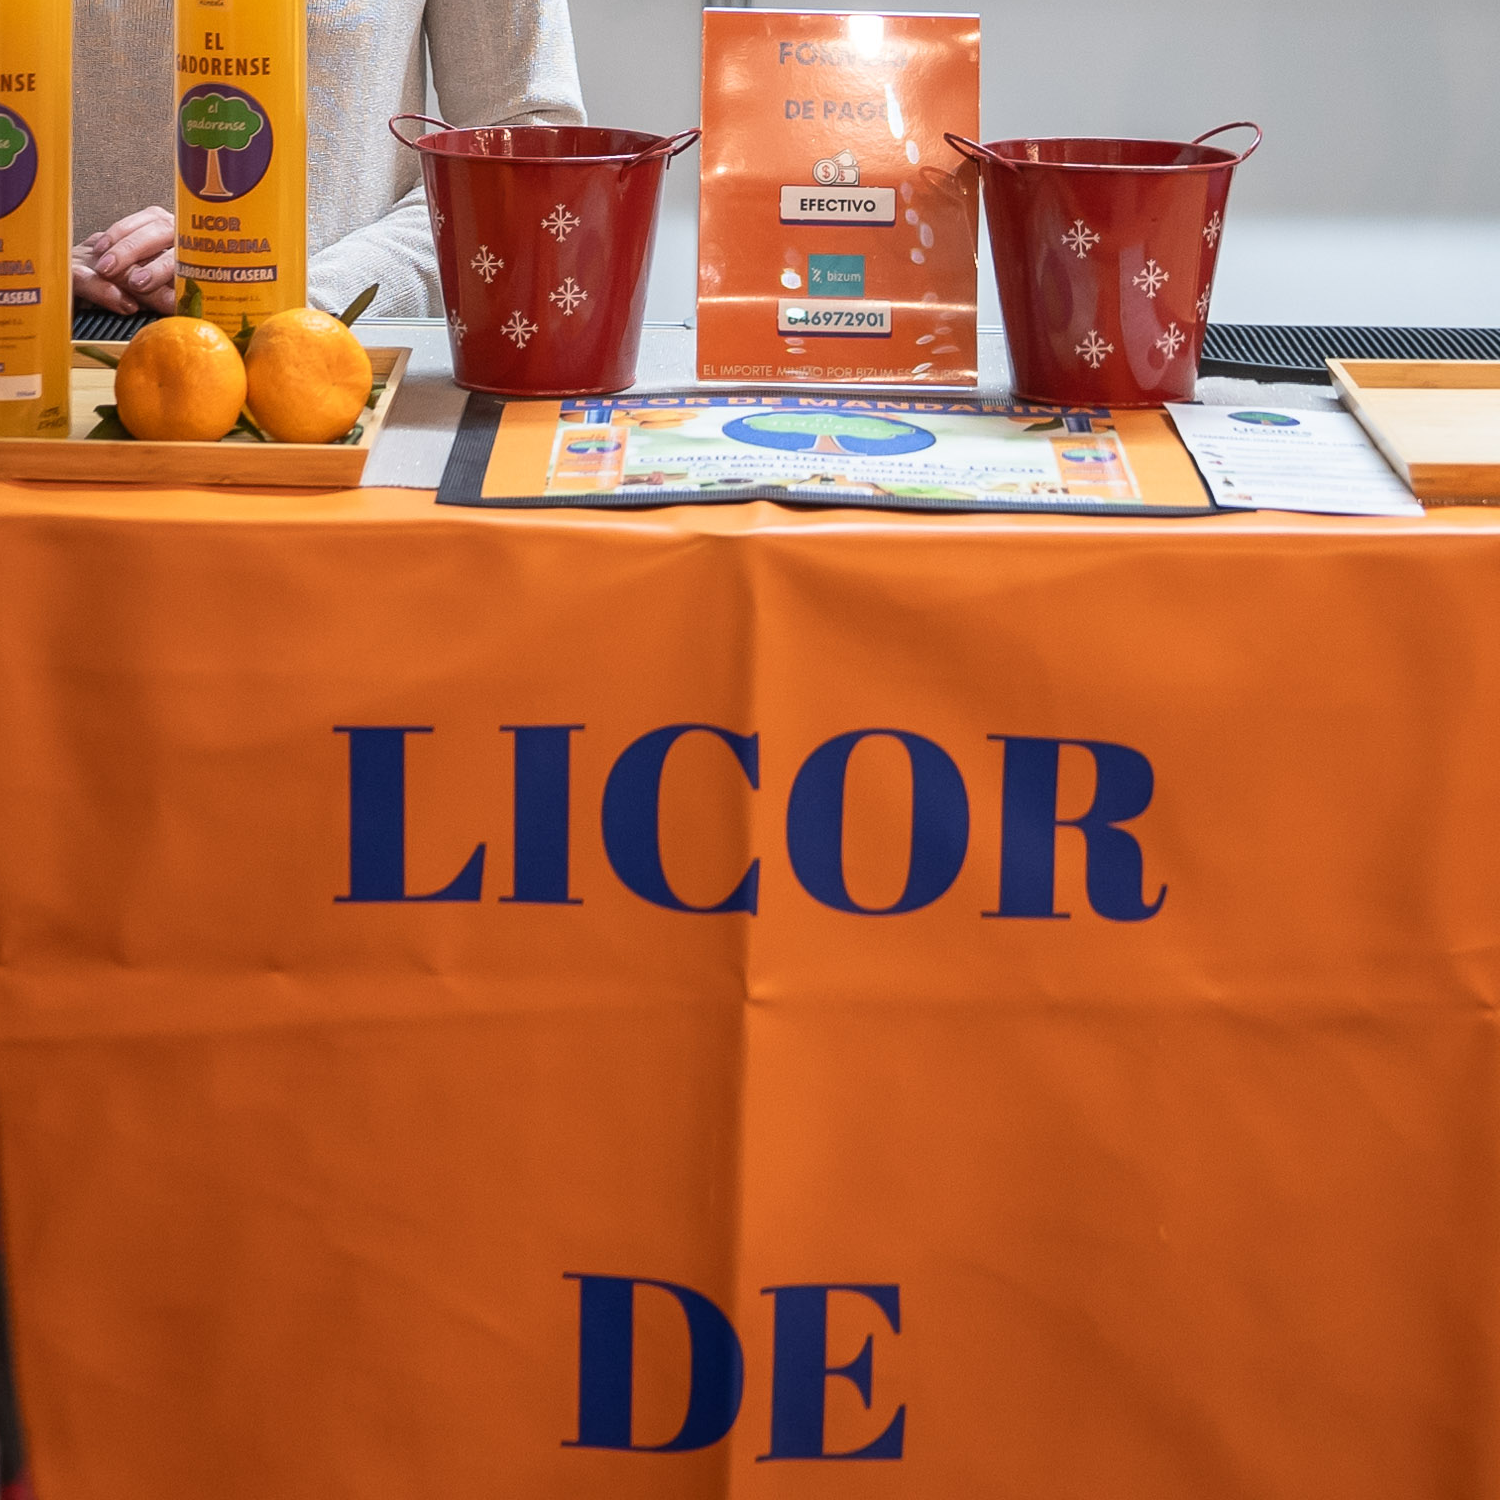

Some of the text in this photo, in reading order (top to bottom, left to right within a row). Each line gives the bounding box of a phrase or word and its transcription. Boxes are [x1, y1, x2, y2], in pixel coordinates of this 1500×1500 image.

[205, 32, 224, 51] EL
[208, 101, 218, 114] el
[785, 100, 814, 120] DE
[187, 117, 246, 132] gadorense
[800, 198, 877, 214] EFECTIVO
[192, 214, 240, 232] LICOR
[233, 269, 274, 282] CASERA
[827, 271, 861, 282] bizum
[703, 365, 716, 376] EL
[720, 365, 773, 377] IMPORTE
[826, 367, 853, 378] POR
[855, 368, 893, 379] BIZUM
[575, 397, 1098, 415] LICOR DE MANDARINA
[330, 722, 1169, 923] LICOR
[561, 1272, 908, 1463] DE
